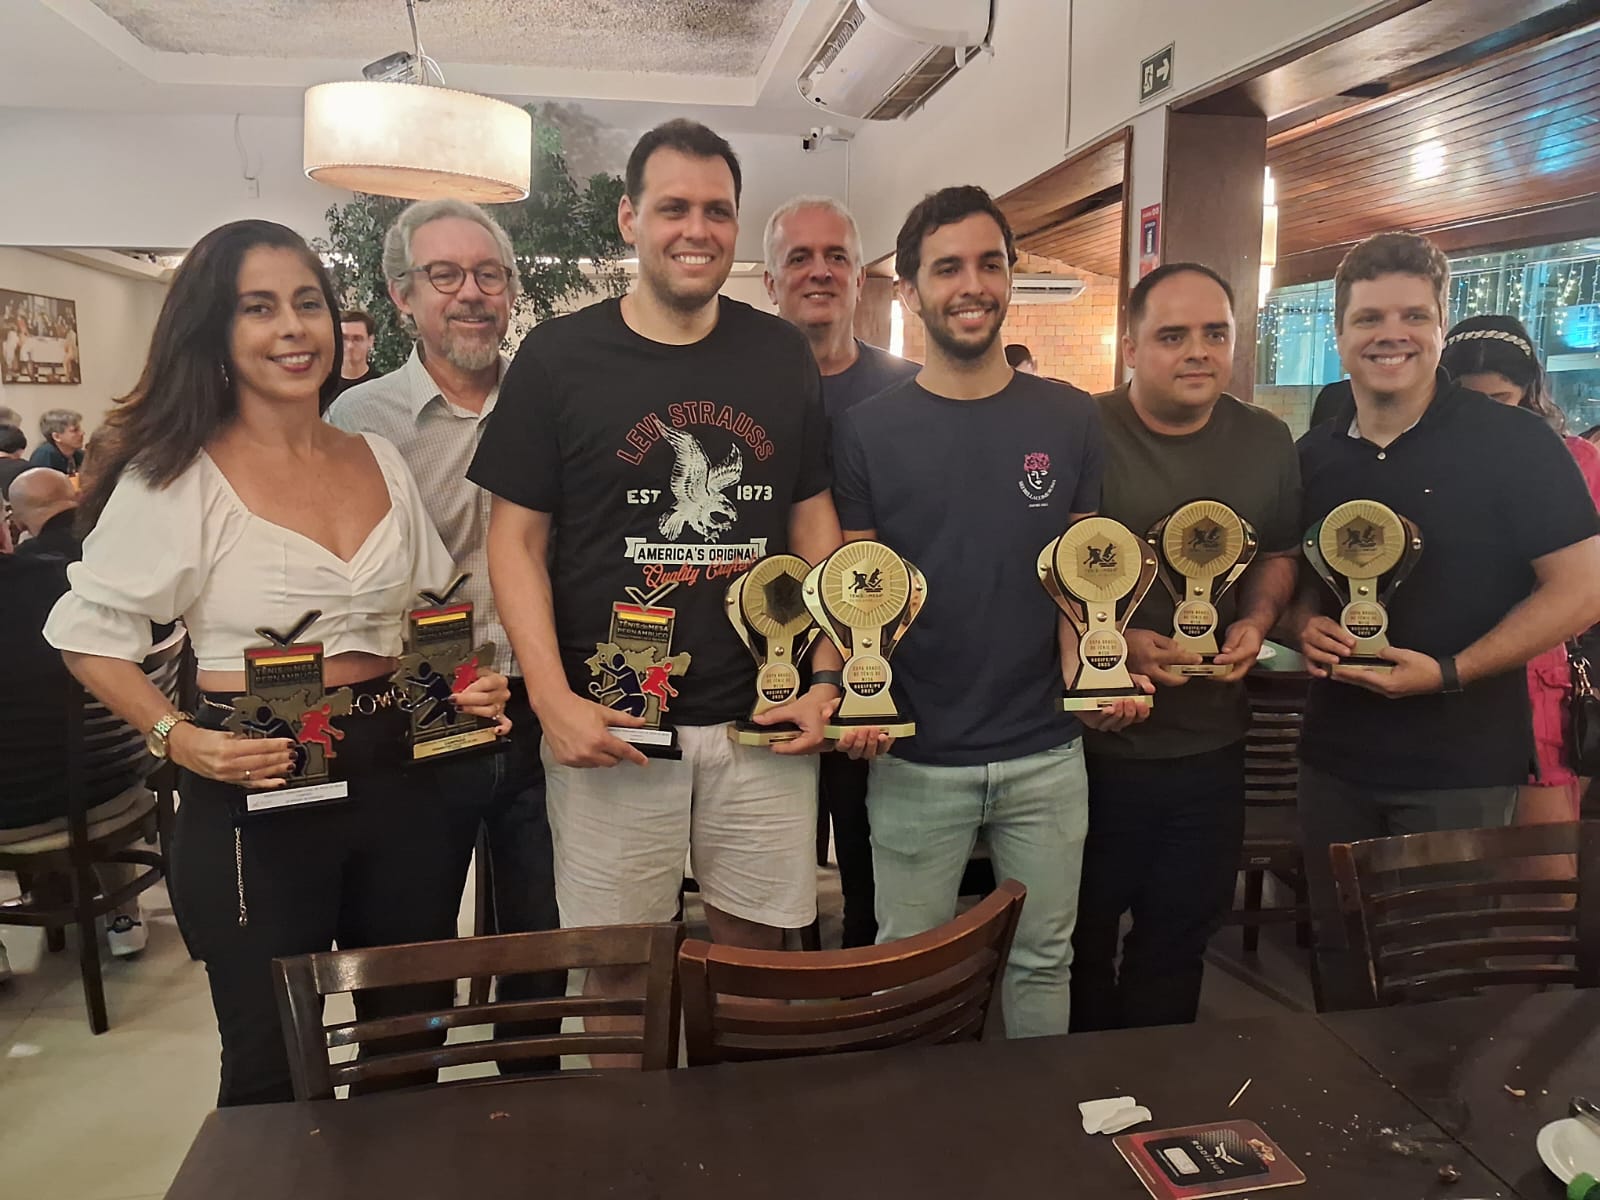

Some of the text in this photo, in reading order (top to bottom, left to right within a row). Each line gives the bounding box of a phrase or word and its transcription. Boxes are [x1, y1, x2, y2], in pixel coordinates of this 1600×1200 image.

[668, 401, 774, 462] STRAUSS
[626, 489, 662, 505] EST
[736, 485, 773, 501] 1873
[637, 546, 705, 561] AMERICA'S
[642, 562, 700, 589] Quality
